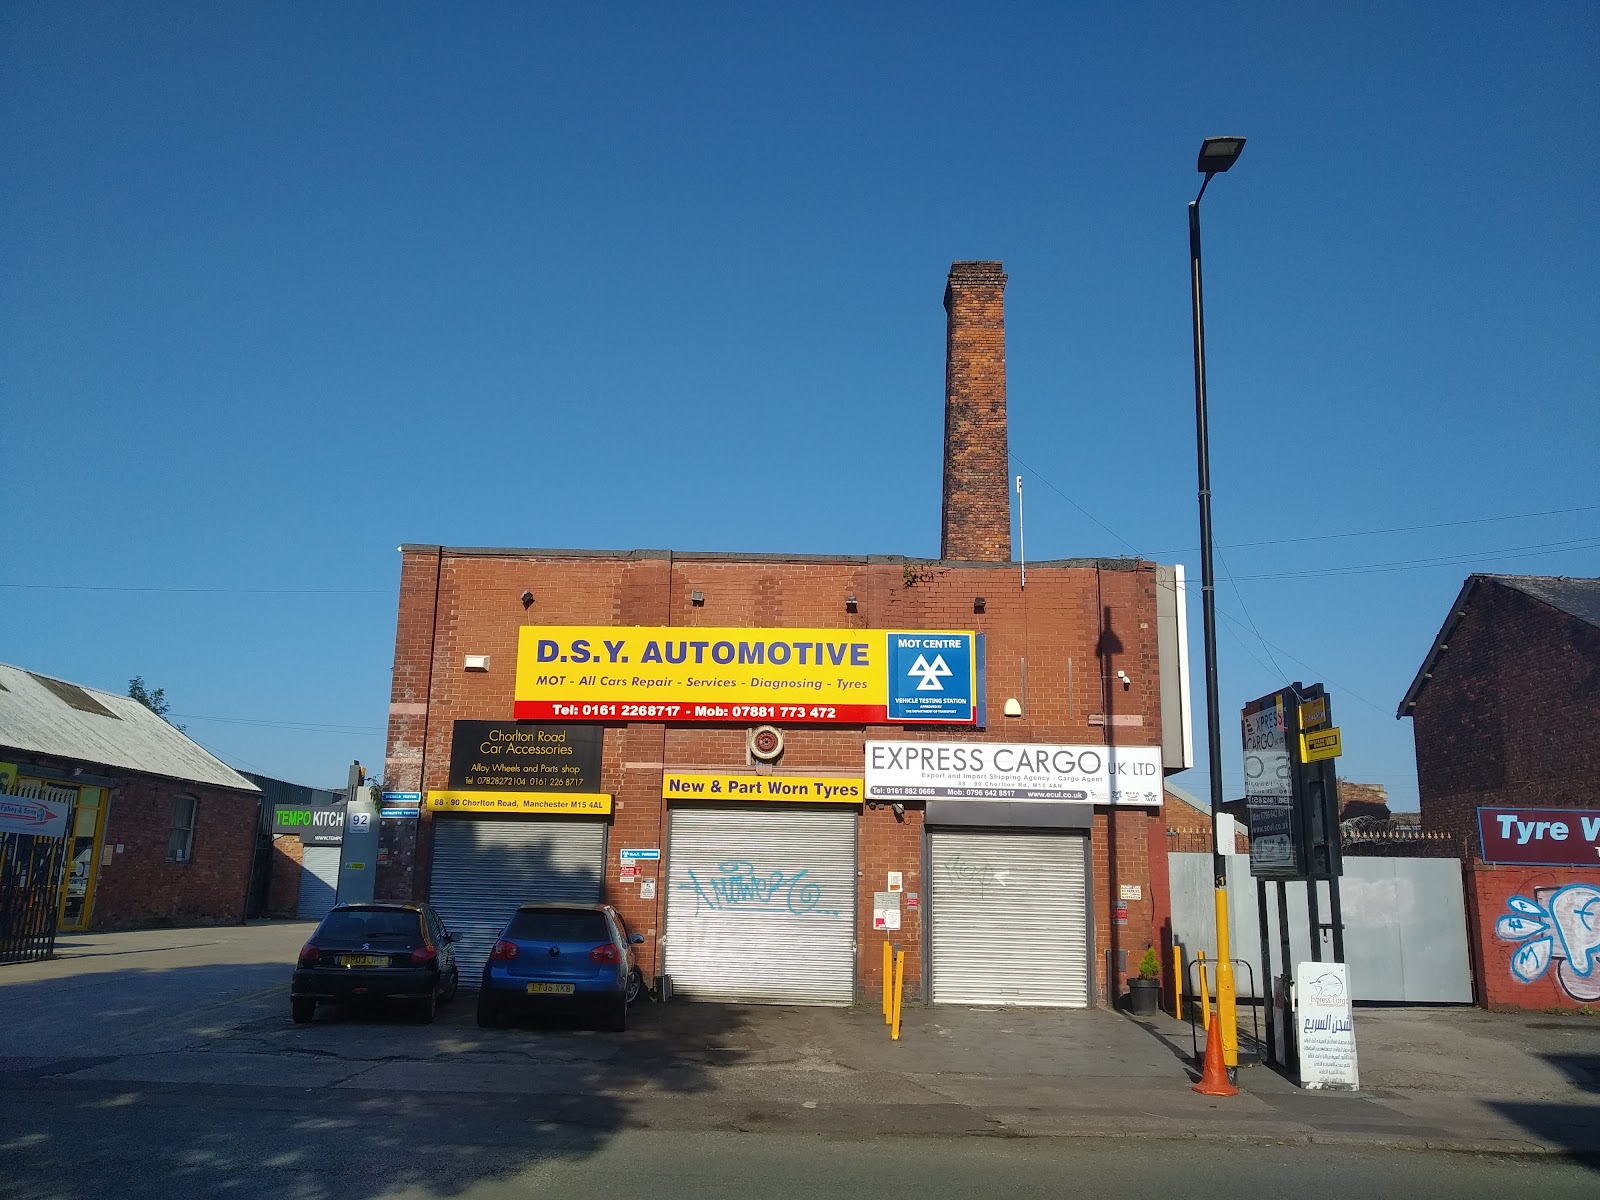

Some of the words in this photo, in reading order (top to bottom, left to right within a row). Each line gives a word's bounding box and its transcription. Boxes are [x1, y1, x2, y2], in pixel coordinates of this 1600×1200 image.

[898, 639, 921, 648] MOT
[923, 640, 962, 648] CENTRE
[536, 640, 629, 664] D.S.Y.
[640, 641, 870, 666] AUTOMOTIVE
[536, 676, 566, 686] MOT
[578, 676, 596, 686] All
[600, 676, 628, 686] Cars
[632, 676, 674, 688] Repair
[686, 677, 736, 687] Services
[750, 678, 822, 690] Diagnosing
[836, 678, 868, 690] Tyres
[552, 704, 578, 716] Tel:
[582, 704, 616, 716] 0161
[621, 705, 680, 716] 2268717
[694, 706, 728, 717] Mob:
[732, 706, 774, 718] 07881
[780, 706, 806, 718] 773
[810, 707, 836, 718] 472
[489, 730, 534, 742] Chorlton
[538, 730, 566, 742] Road
[480, 742, 502, 754] Car
[506, 742, 572, 755] Accessories
[872, 746, 984, 772] EXPRESS
[993, 748, 1102, 774] CARGO
[1108, 762, 1127, 775] UK
[1133, 763, 1156, 776] LTD
[471, 764, 490, 773] Alloy
[492, 764, 520, 773] Wheels
[523, 764, 538, 773] and
[541, 764, 558, 773] Parts
[561, 765, 580, 775] shop
[465, 776, 474, 785] Tel
[478, 777, 526, 785] 07828272104
[530, 778, 547, 786] 0161
[550, 778, 563, 786] 226
[565, 778, 584, 786] 8717
[669, 779, 705, 792] New
[710, 780, 722, 793] &
[728, 780, 762, 794] Part
[768, 782, 808, 795] Worn
[814, 782, 858, 799] Tyres
[276, 810, 312, 826] TEMPO
[353, 815, 368, 825] 92
[1496, 815, 1570, 845] Tyre
